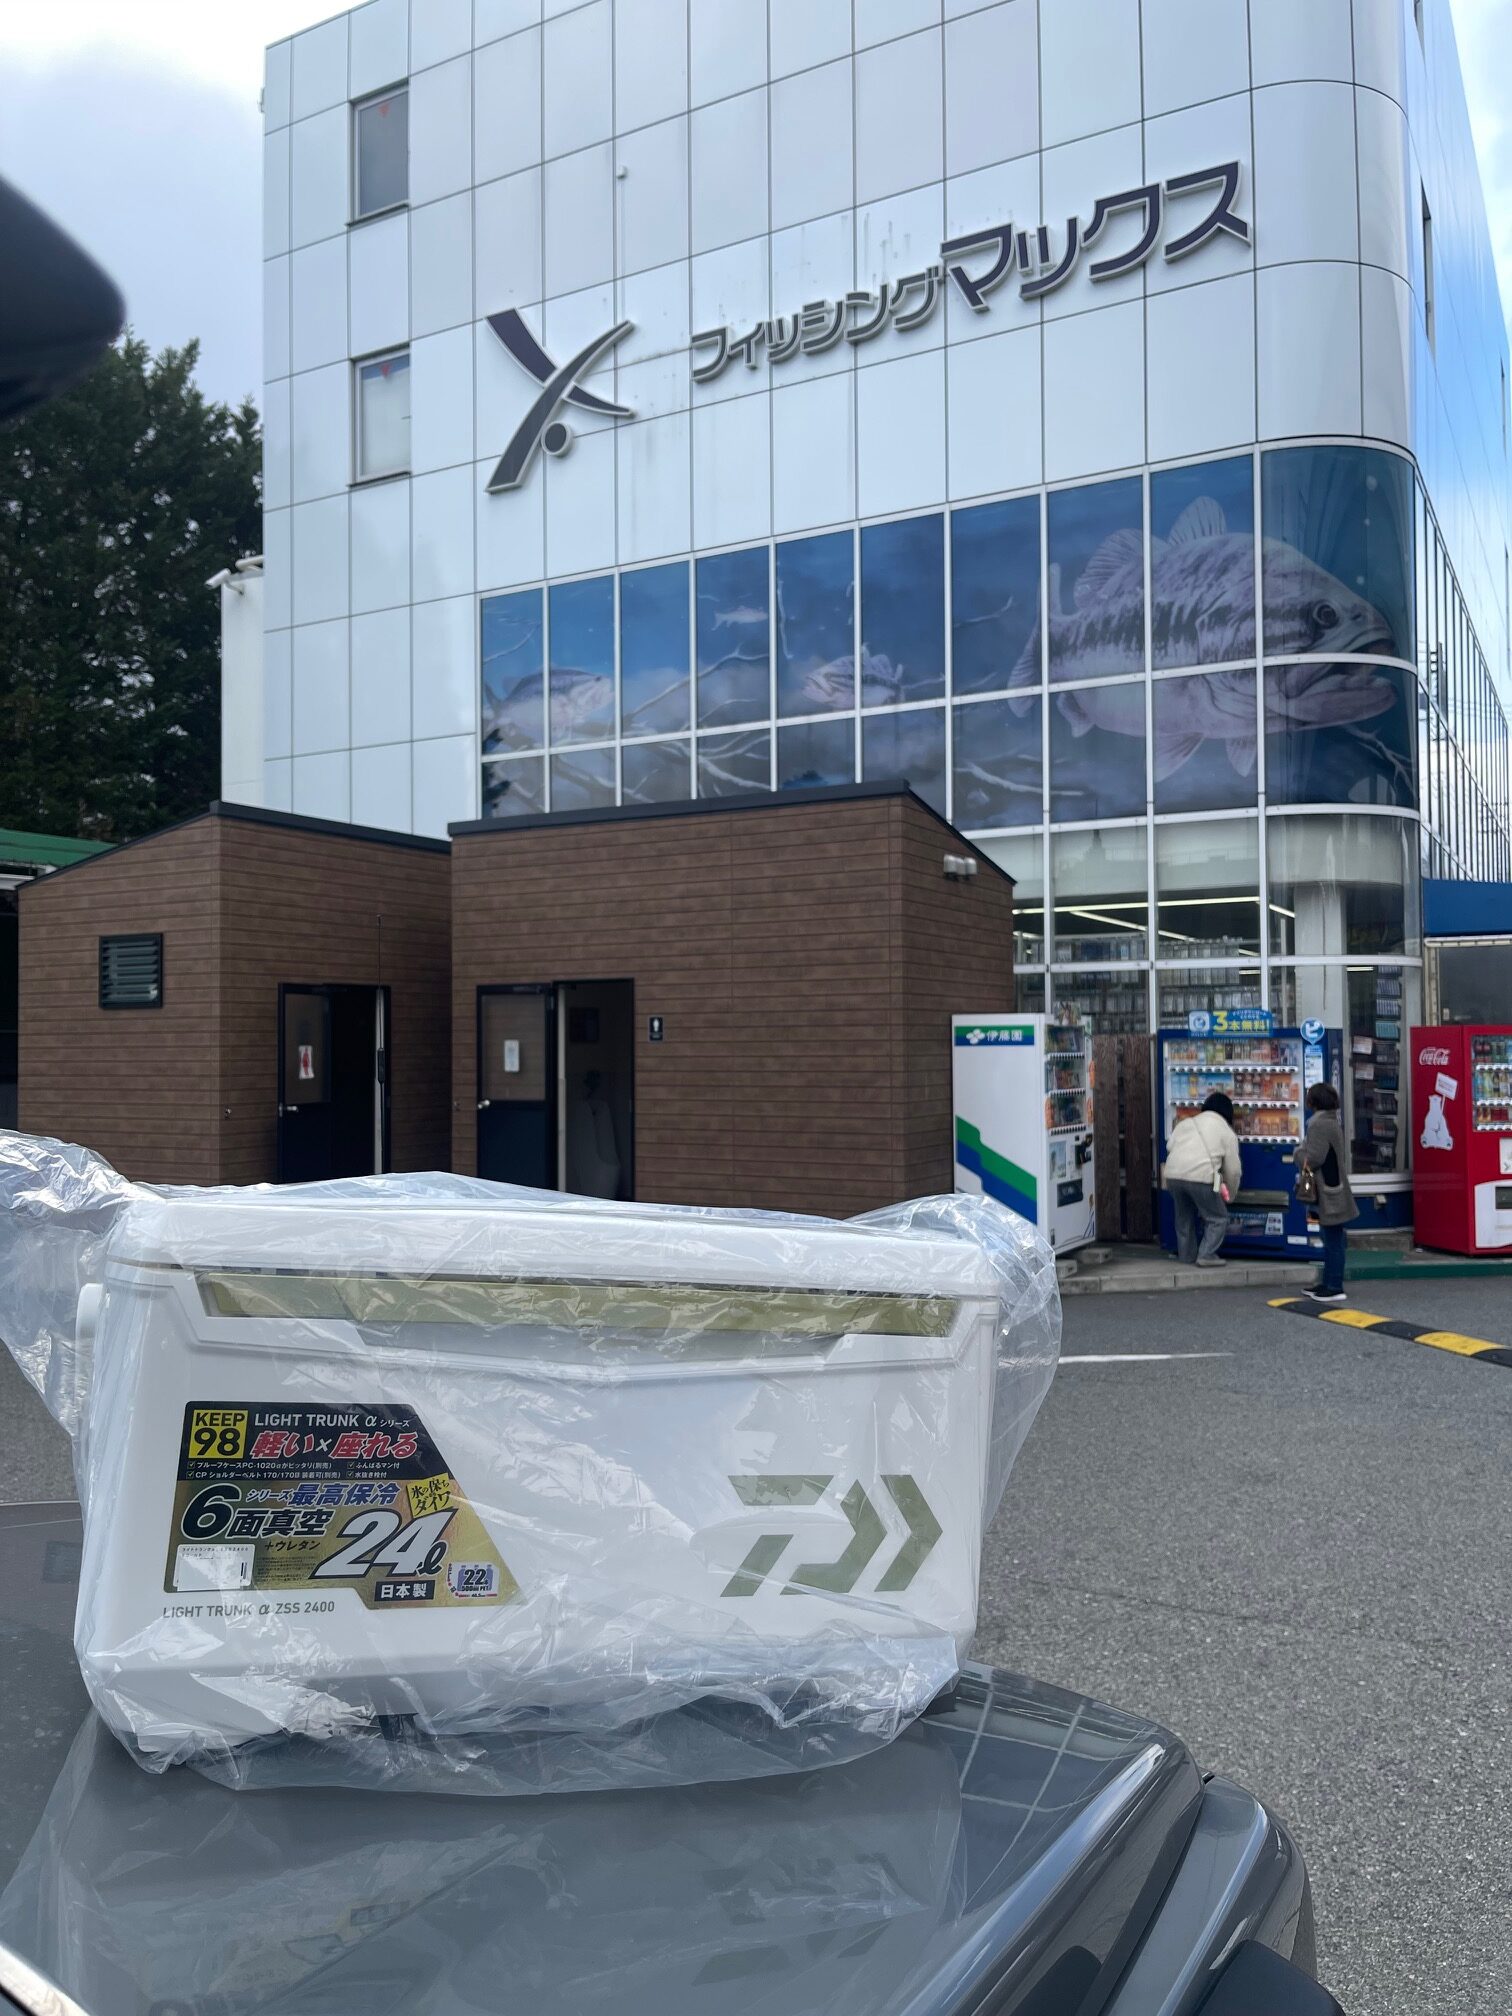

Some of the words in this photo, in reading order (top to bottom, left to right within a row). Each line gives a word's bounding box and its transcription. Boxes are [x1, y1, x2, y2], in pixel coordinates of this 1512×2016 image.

[689, 159, 1252, 383] フィッシングマックス
[986, 1029, 1023, 1042] 伊藤園
[195, 1412, 246, 1427] KEEP
[254, 1413, 302, 1426] LIGHT
[306, 1414, 359, 1427] TRUNK
[380, 1419, 410, 1428] シリーズ
[194, 1428, 241, 1456] 98
[381, 1583, 427, 1598] 日本製
[163, 1605, 203, 1618] LIGHT
[206, 1604, 251, 1617] TRUNK
[275, 1602, 300, 1614] ZSS
[304, 1601, 335, 1613] 2400
